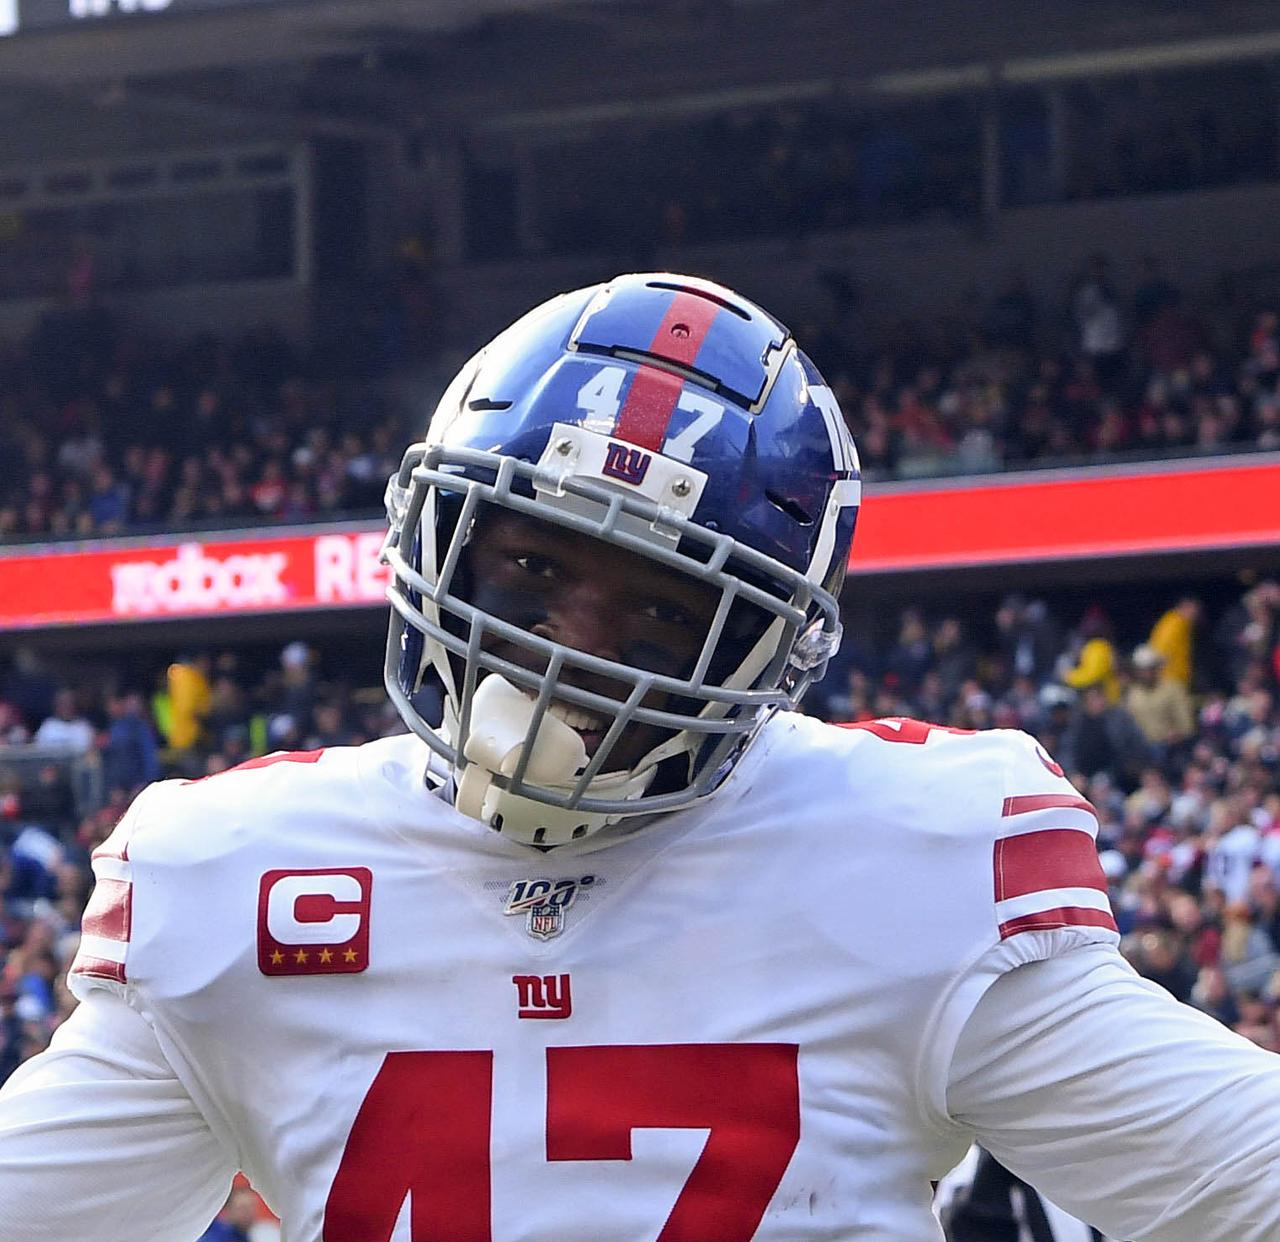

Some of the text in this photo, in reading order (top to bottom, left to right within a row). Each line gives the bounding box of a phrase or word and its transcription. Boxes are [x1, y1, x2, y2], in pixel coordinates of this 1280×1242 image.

[577, 366, 725, 464] 47
[267, 874, 363, 946] C
[533, 916, 557, 934] NFL
[512, 973, 573, 1020] ny
